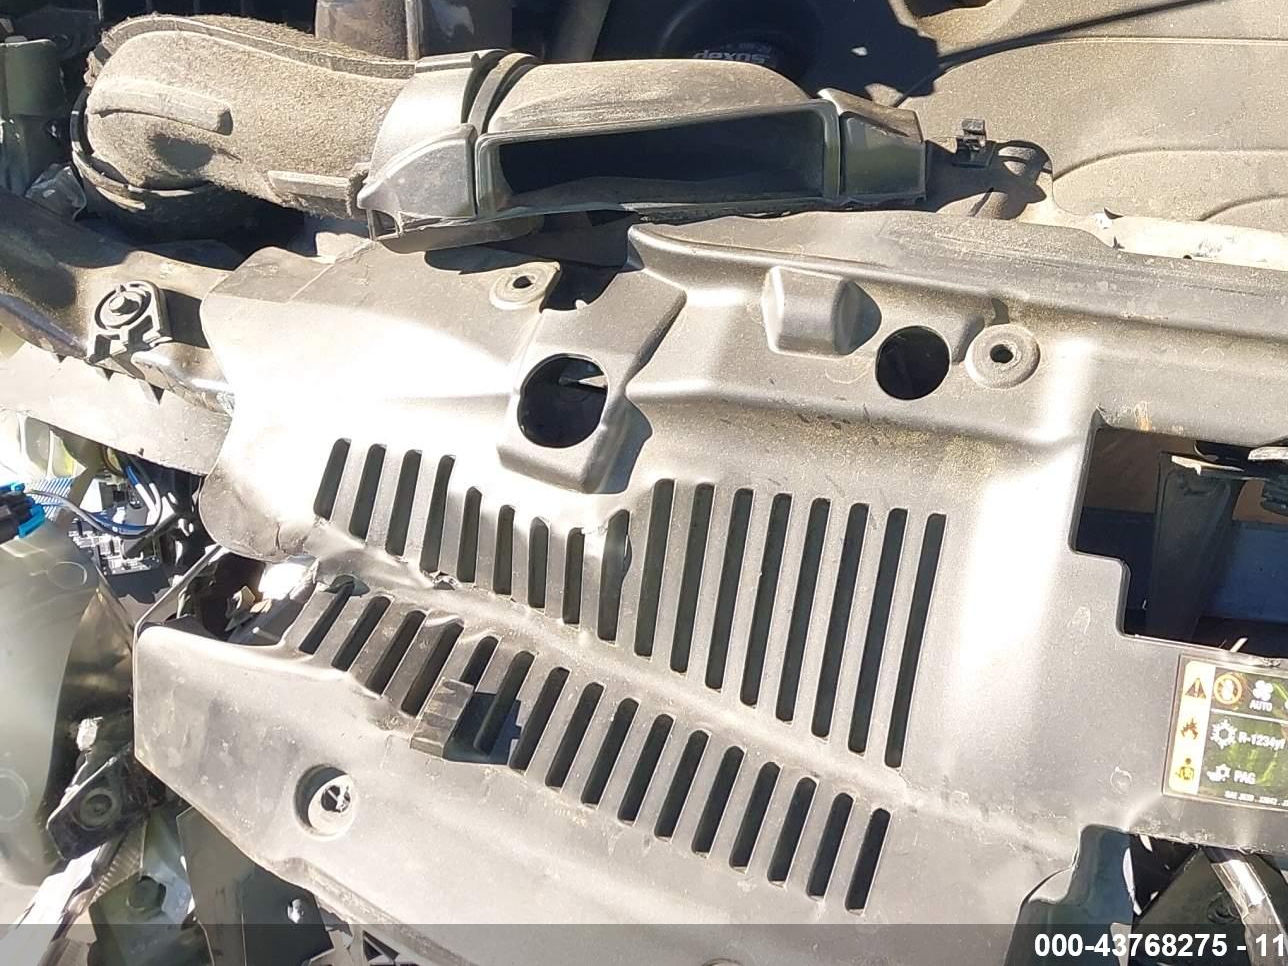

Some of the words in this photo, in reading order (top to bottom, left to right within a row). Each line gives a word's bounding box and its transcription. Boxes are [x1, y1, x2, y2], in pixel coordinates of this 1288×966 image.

[692, 50, 770, 64] dexos
[1249, 699, 1272, 712] AUTO
[1238, 731, 1286, 750] R-1234yf
[1233, 770, 1256, 784] PAG
